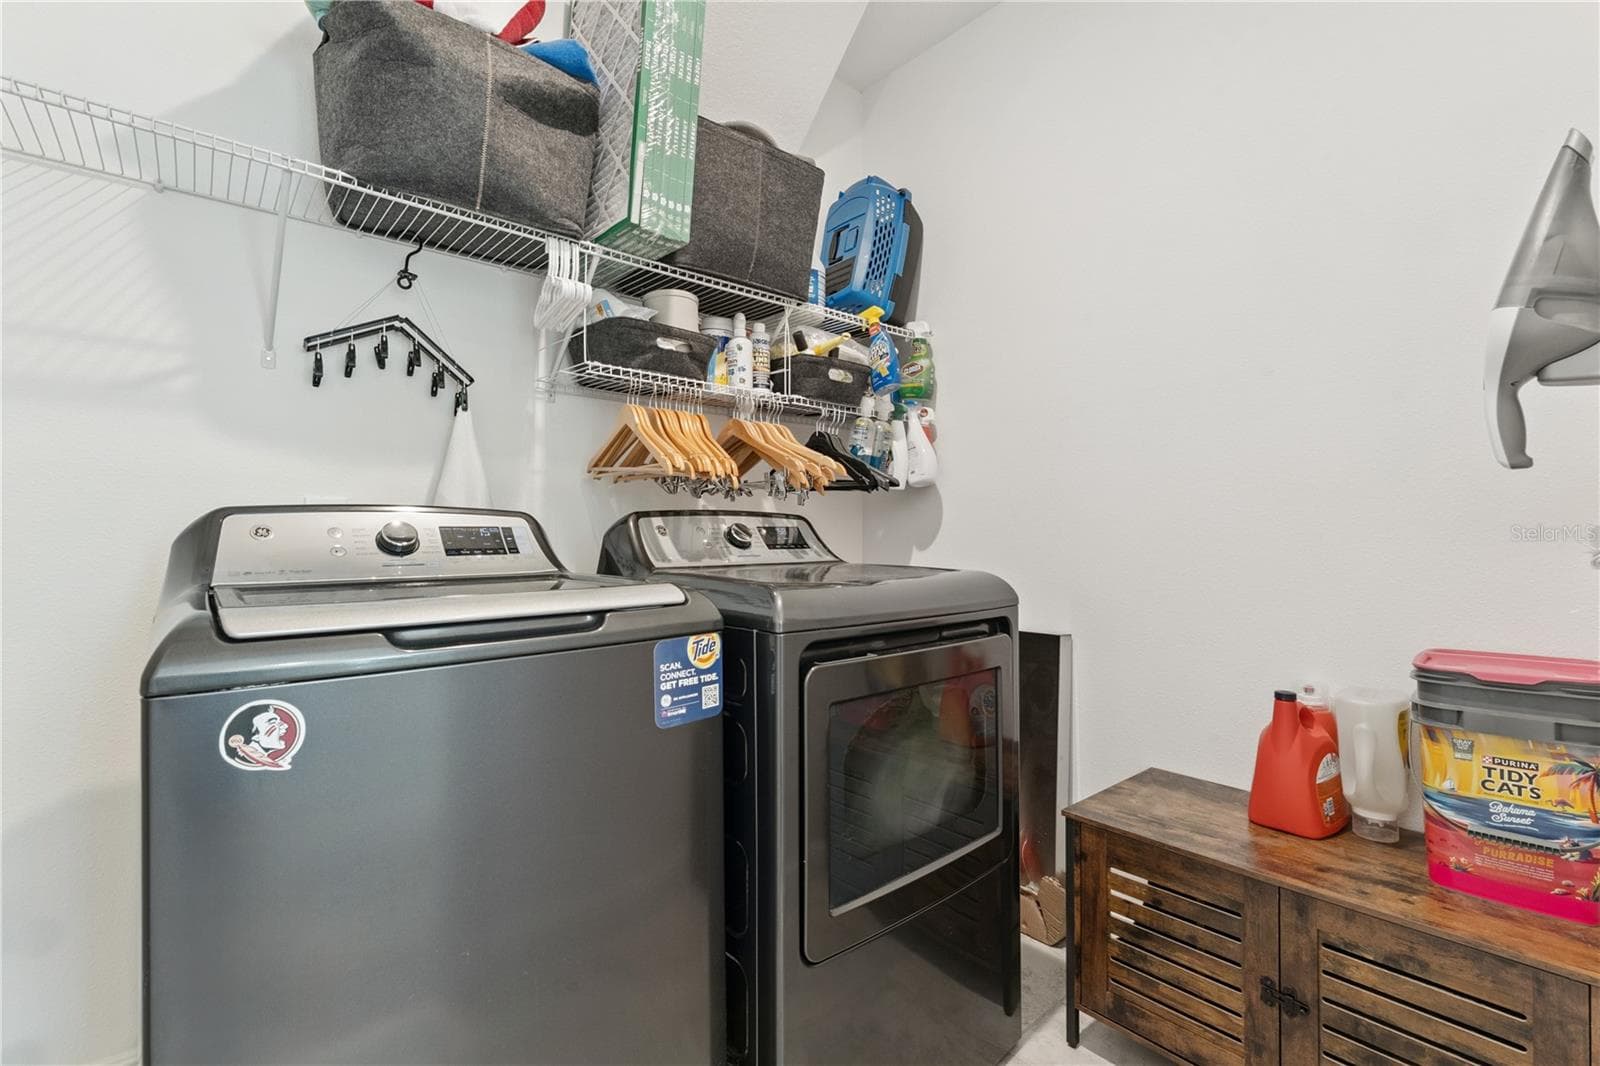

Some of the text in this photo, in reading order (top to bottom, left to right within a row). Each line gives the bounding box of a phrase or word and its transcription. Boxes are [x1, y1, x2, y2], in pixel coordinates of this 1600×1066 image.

[692, 638, 716, 661] Tide
[660, 662, 682, 672] SCAN.
[660, 668, 696, 681] CONNECT.
[660, 672, 719, 691] GET FREE TIDE.
[1494, 758, 1537, 769] PURINA
[1482, 766, 1538, 785] TIDY
[1481, 779, 1541, 799] CATS
[1489, 801, 1536, 817] Bahama
[1491, 813, 1534, 825] Sunset
